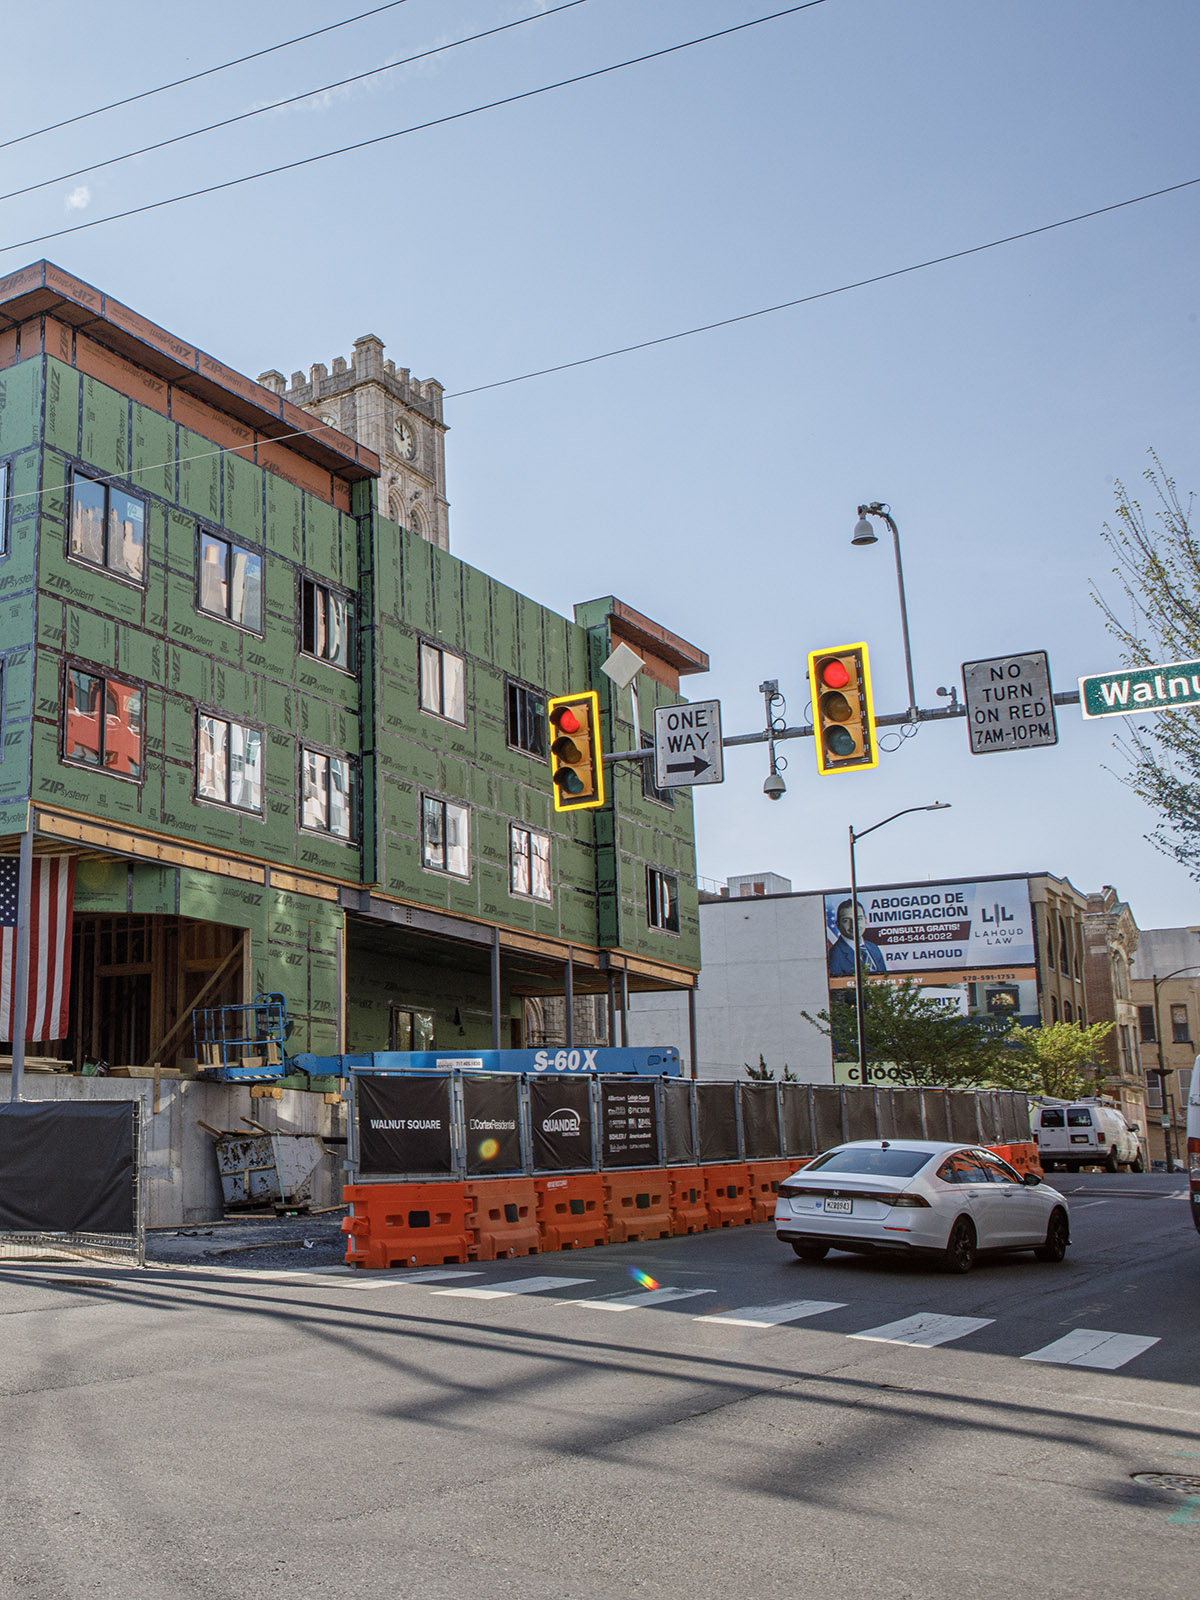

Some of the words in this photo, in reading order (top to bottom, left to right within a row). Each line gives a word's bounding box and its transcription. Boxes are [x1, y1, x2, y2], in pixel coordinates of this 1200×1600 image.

[990, 664, 1022, 683] NO
[982, 683, 1033, 702] TURN
[667, 709, 708, 731] ONE
[975, 706, 1003, 724] ON
[1009, 701, 1046, 721] RED
[667, 731, 710, 753] WAY
[974, 722, 1051, 745] 7AM-10PM
[38, 777, 90, 802] ZIPsystem
[870, 893, 941, 910] ABOGADO
[945, 892, 965, 904] DE
[868, 904, 969, 923] INMIGRACIÓN
[927, 923, 961, 933] GRATIS!
[975, 928, 1024, 938] LAHOUD
[887, 933, 953, 944] 484-544-0022
[987, 937, 1013, 946] LAW
[886, 952, 909, 962] RAY
[913, 948, 963, 961] LAHOUD
[370, 1119, 406, 1129] WALNUT
[407, 1119, 441, 1130] SQUARE
[542, 1119, 580, 1132] QUANDEL
